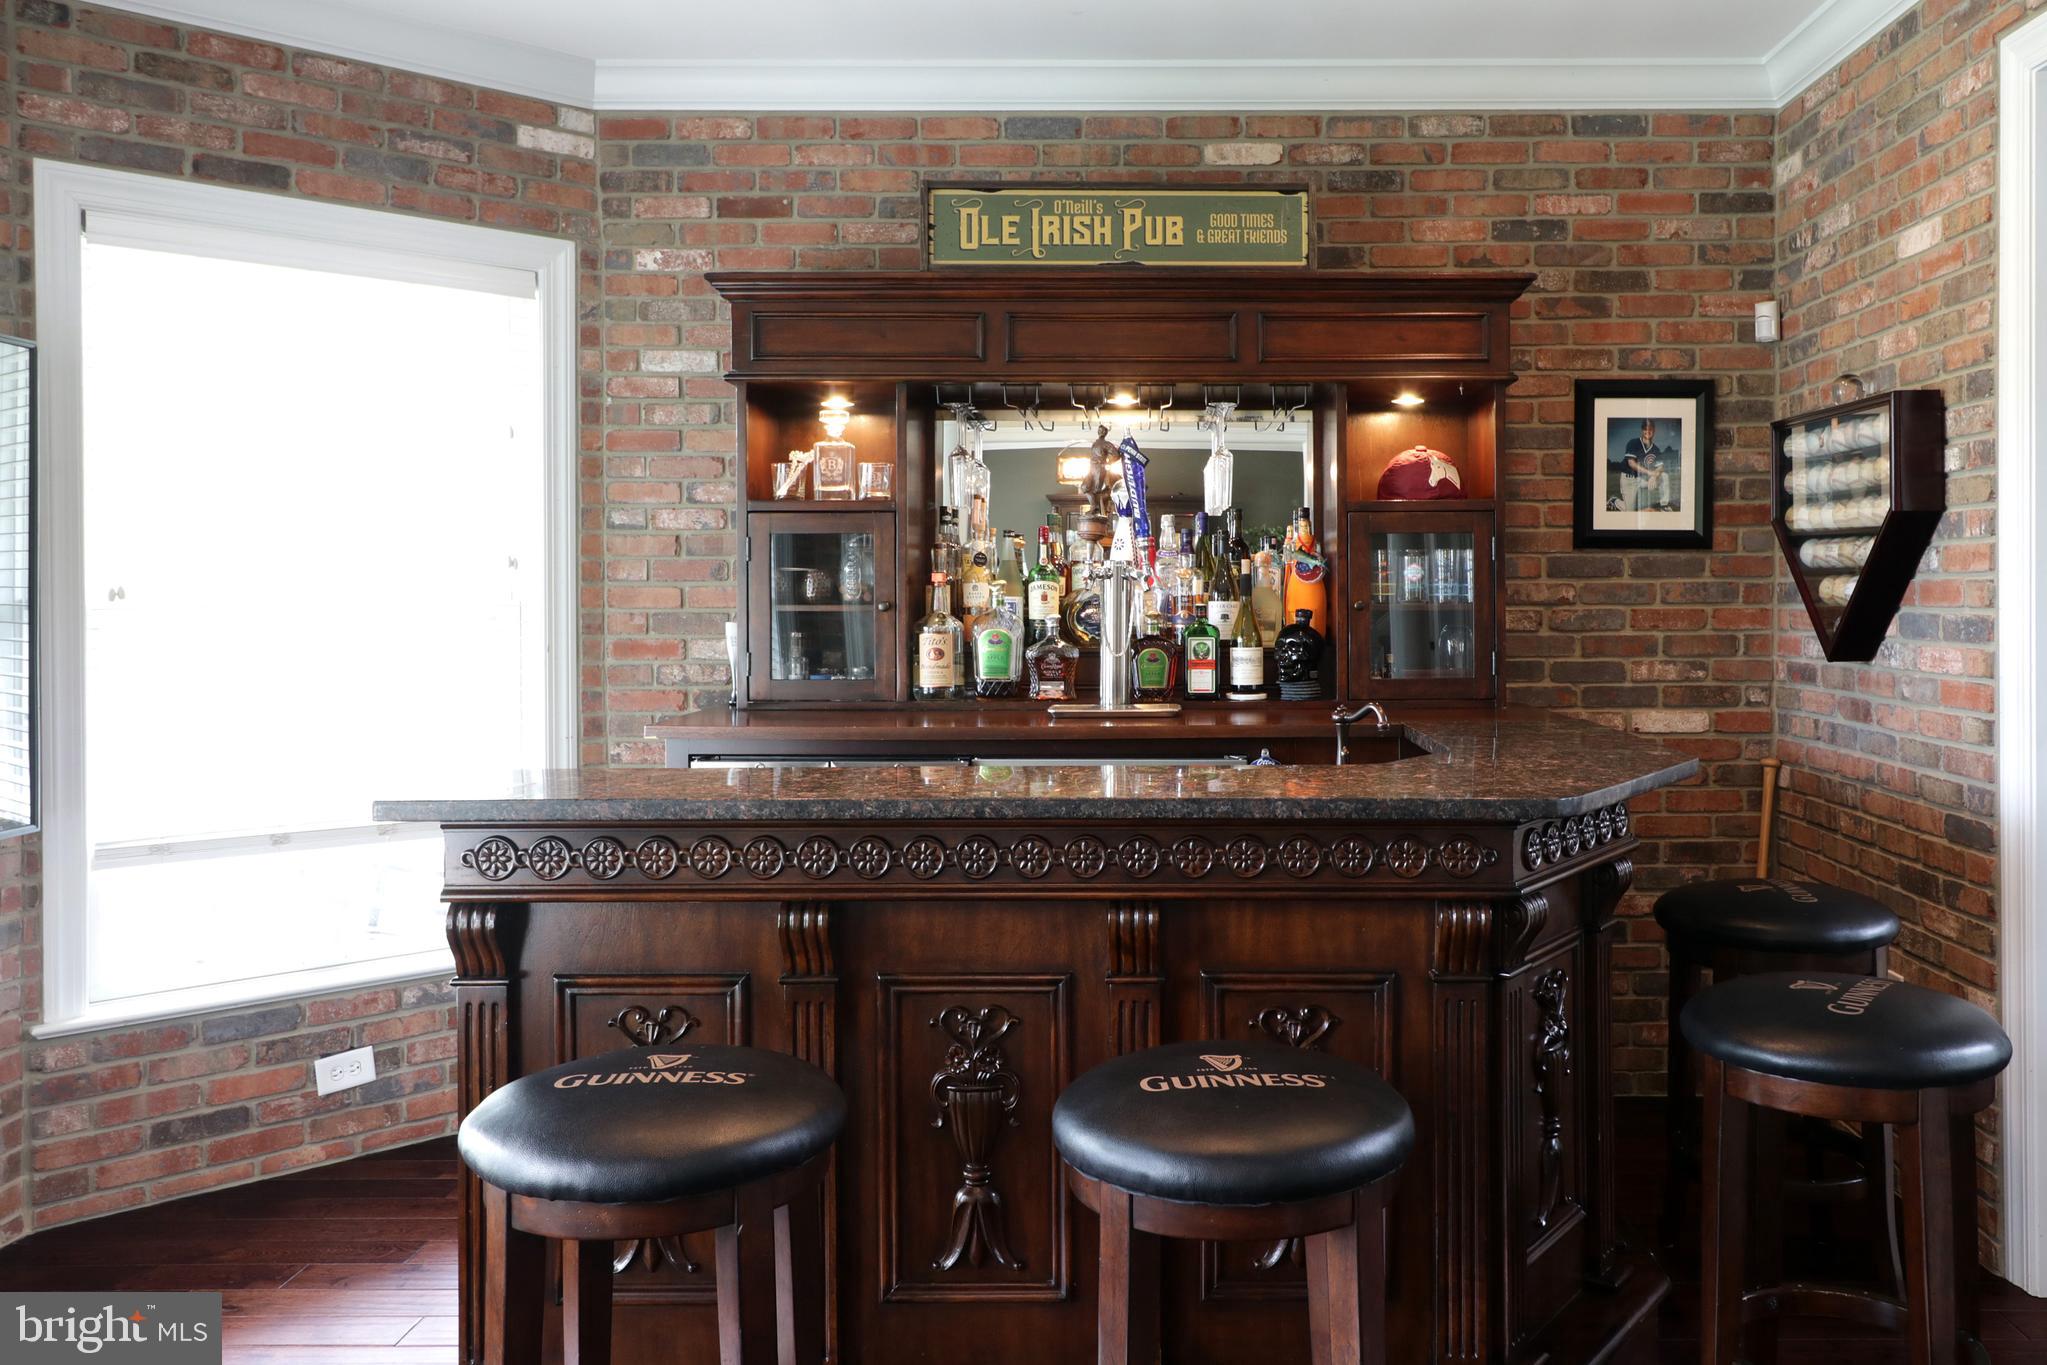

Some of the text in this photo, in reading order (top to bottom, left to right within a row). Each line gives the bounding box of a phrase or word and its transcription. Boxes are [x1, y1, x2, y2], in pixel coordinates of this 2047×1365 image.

[1054, 199, 1104, 215] O'Neill's
[1114, 198, 1185, 259] PUB
[1210, 213, 1275, 228] GOOD TIMES
[1196, 228, 1288, 244] & GREAT FRIENDS
[827, 459, 836, 470] B
[1030, 583, 1058, 592] JAMESON
[553, 1070, 747, 1089] GUINNESS
[1139, 1073, 1326, 1092] GUINNESS
